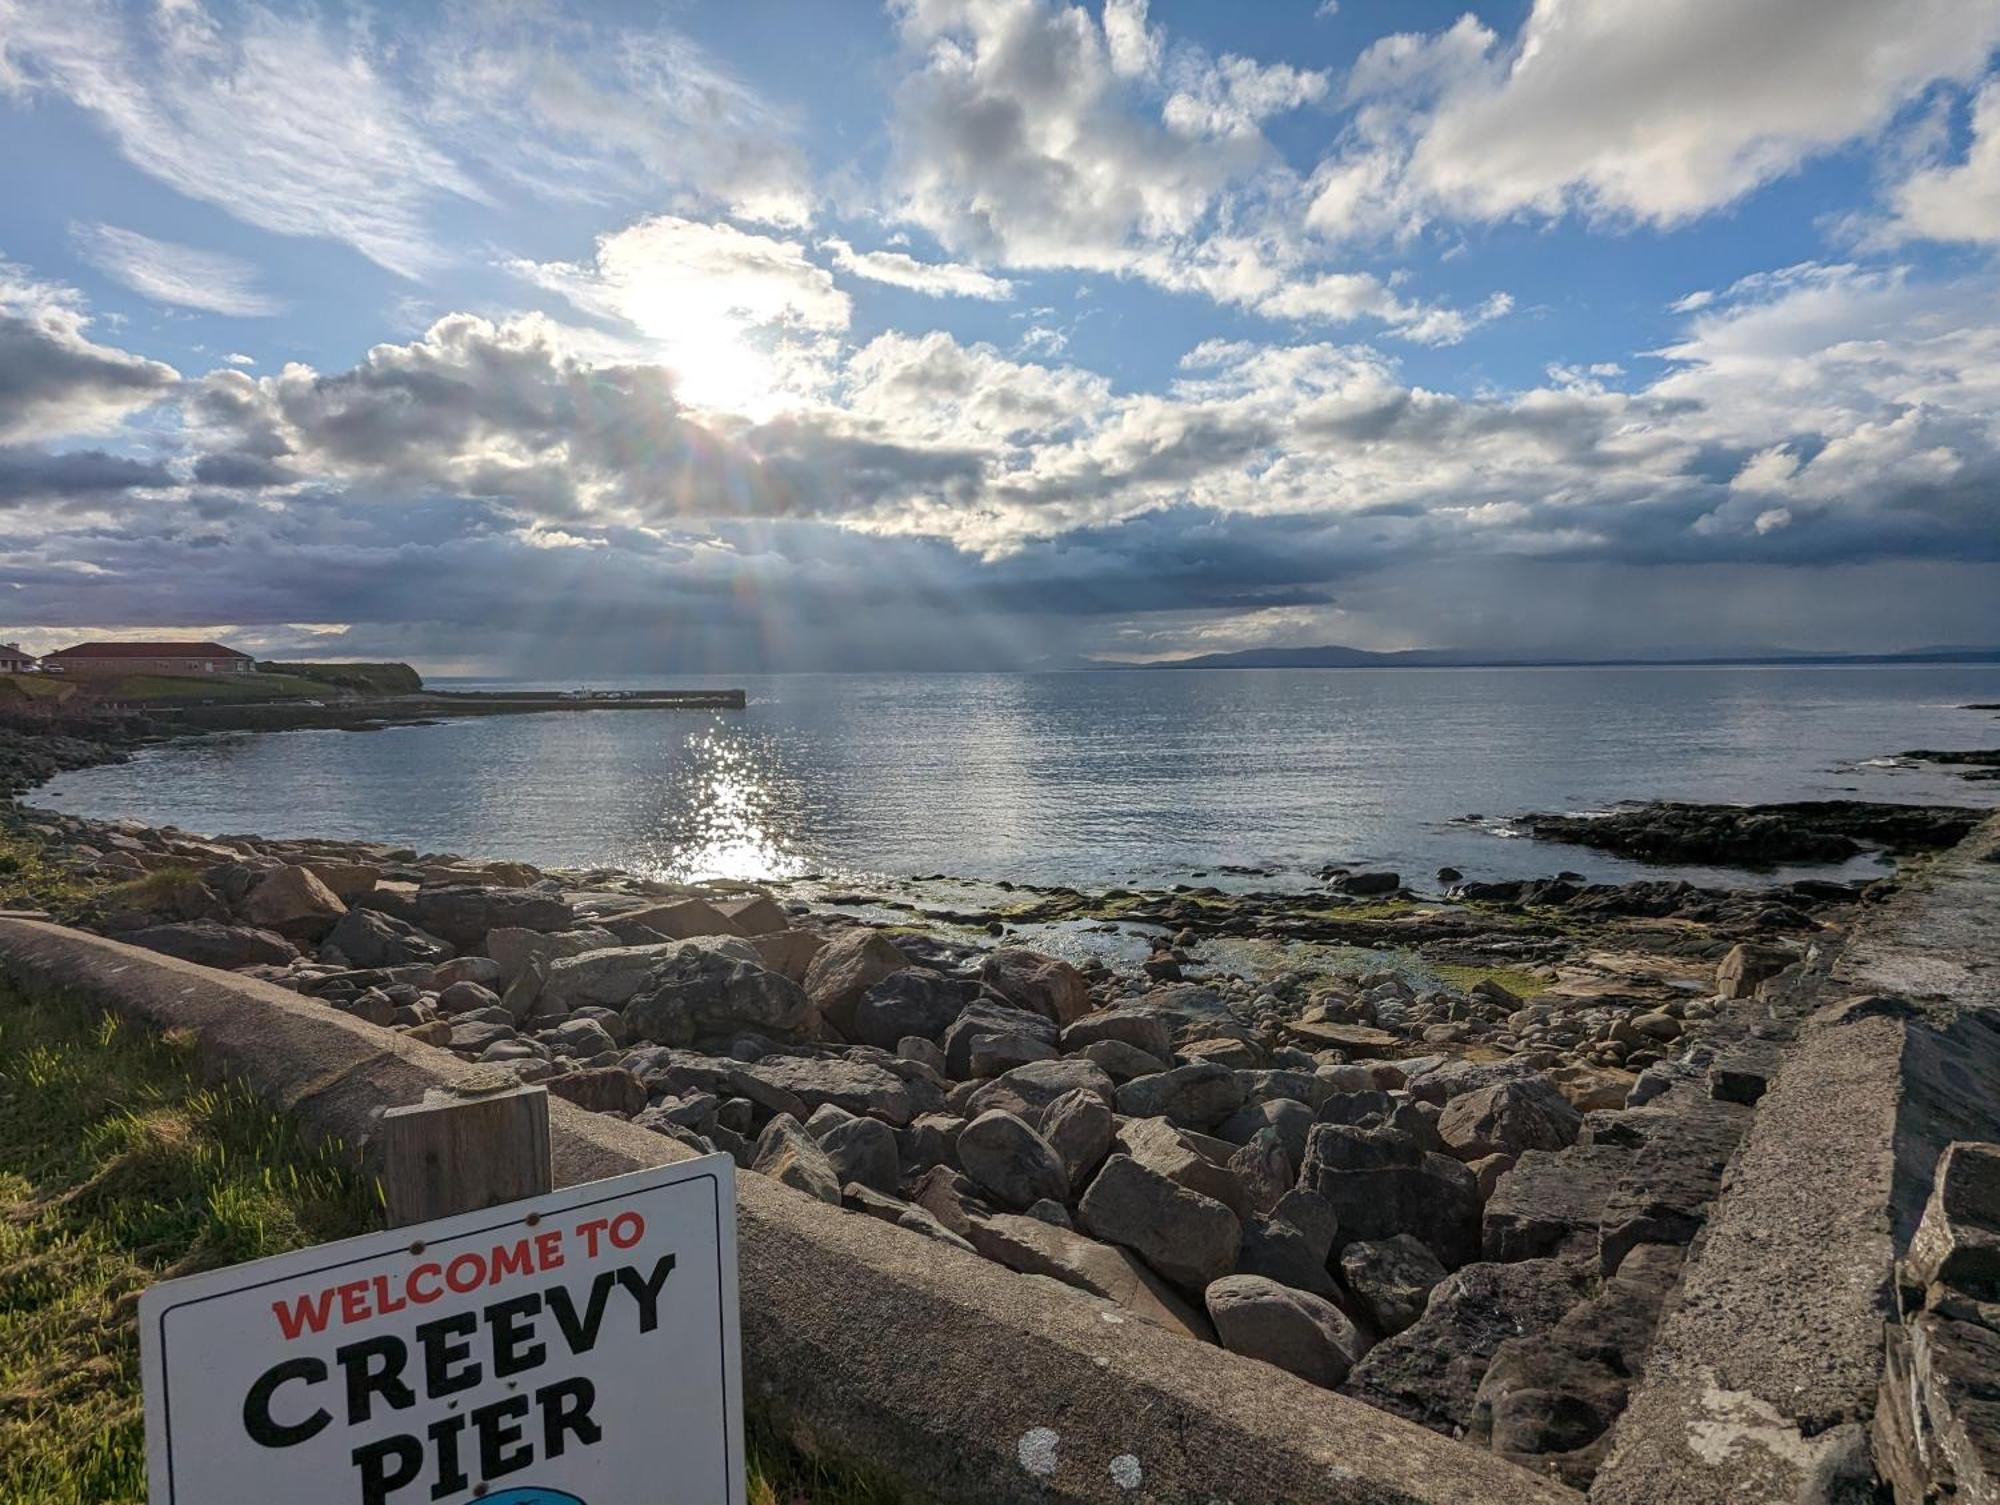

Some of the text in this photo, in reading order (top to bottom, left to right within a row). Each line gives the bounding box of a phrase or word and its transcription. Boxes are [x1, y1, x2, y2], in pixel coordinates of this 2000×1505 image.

[272, 1211, 645, 1339] WELCOME TO
[243, 1253, 676, 1448] CREEVY
[352, 1376, 602, 1505] PIER
